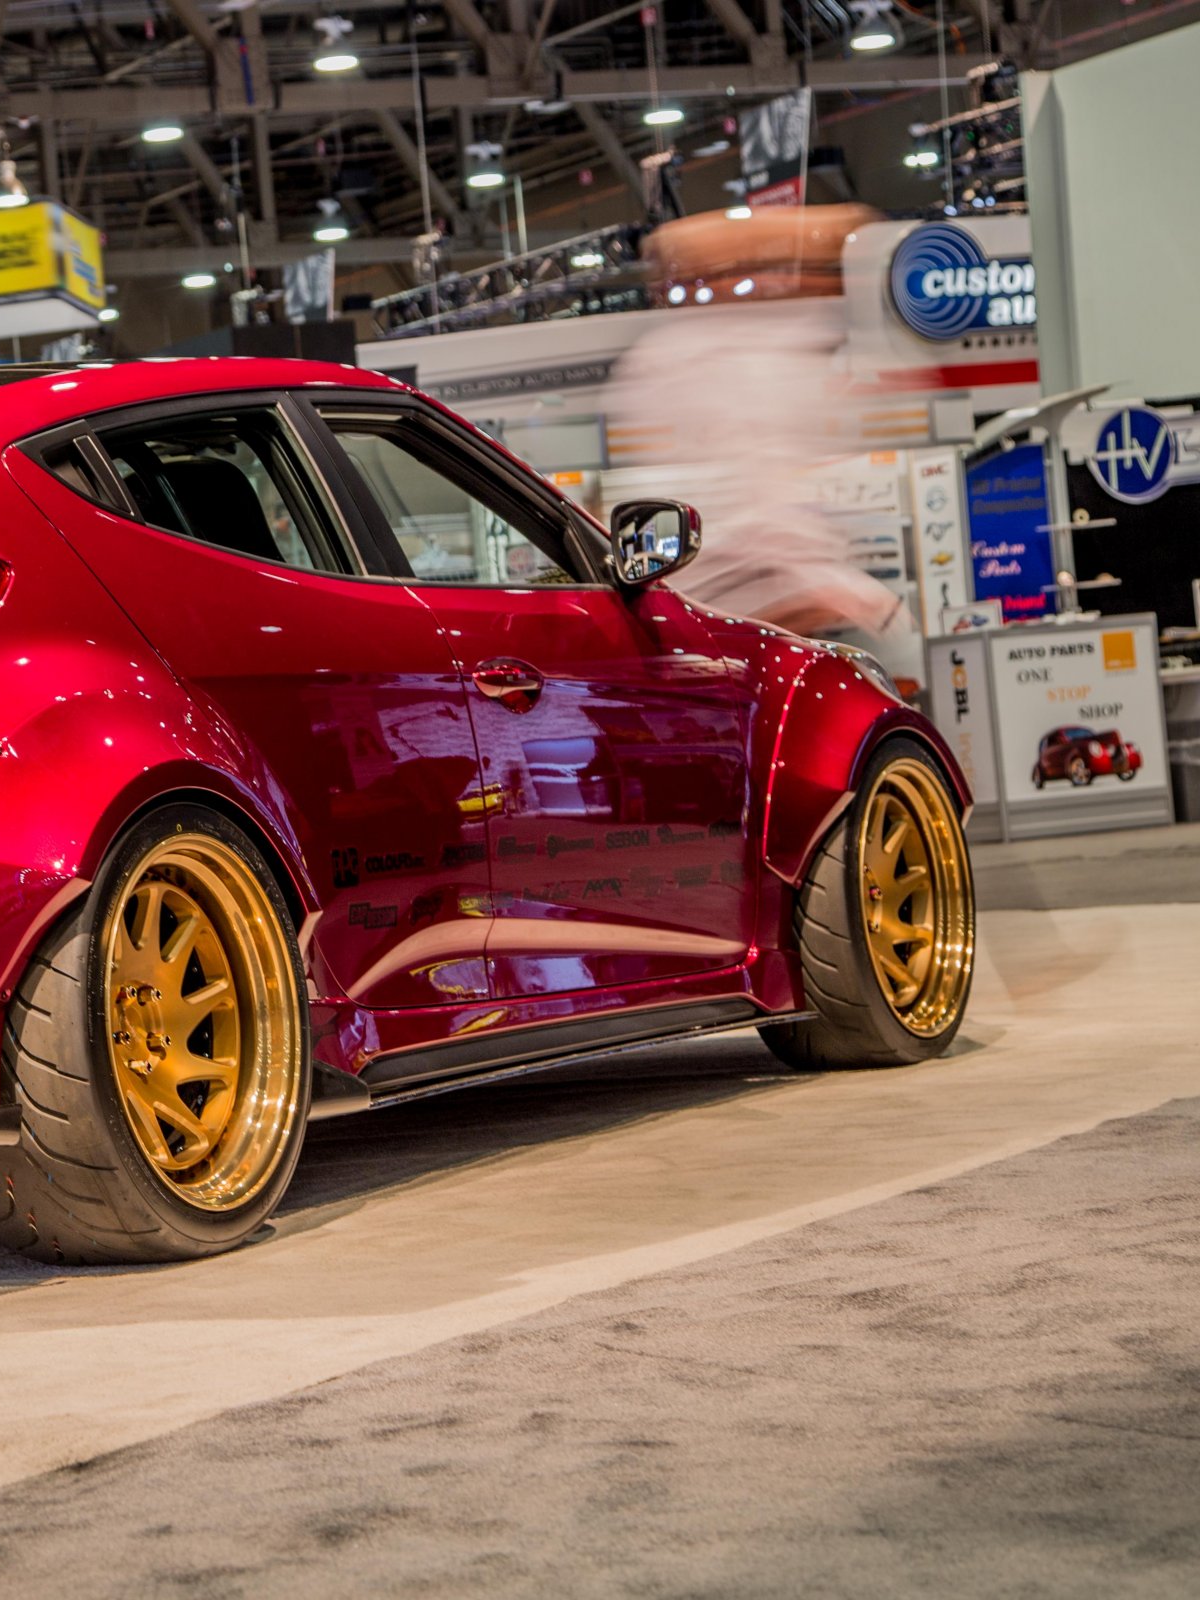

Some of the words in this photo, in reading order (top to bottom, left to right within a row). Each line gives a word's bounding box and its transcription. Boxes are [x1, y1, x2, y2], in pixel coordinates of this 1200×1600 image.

[524, 370, 563, 386] AUTO
[1009, 647, 1046, 660] AUTO
[1050, 642, 1094, 656] PARTS
[1018, 667, 1052, 684] ONE
[1047, 685, 1092, 703] STOP
[1079, 702, 1123, 719] SHOP
